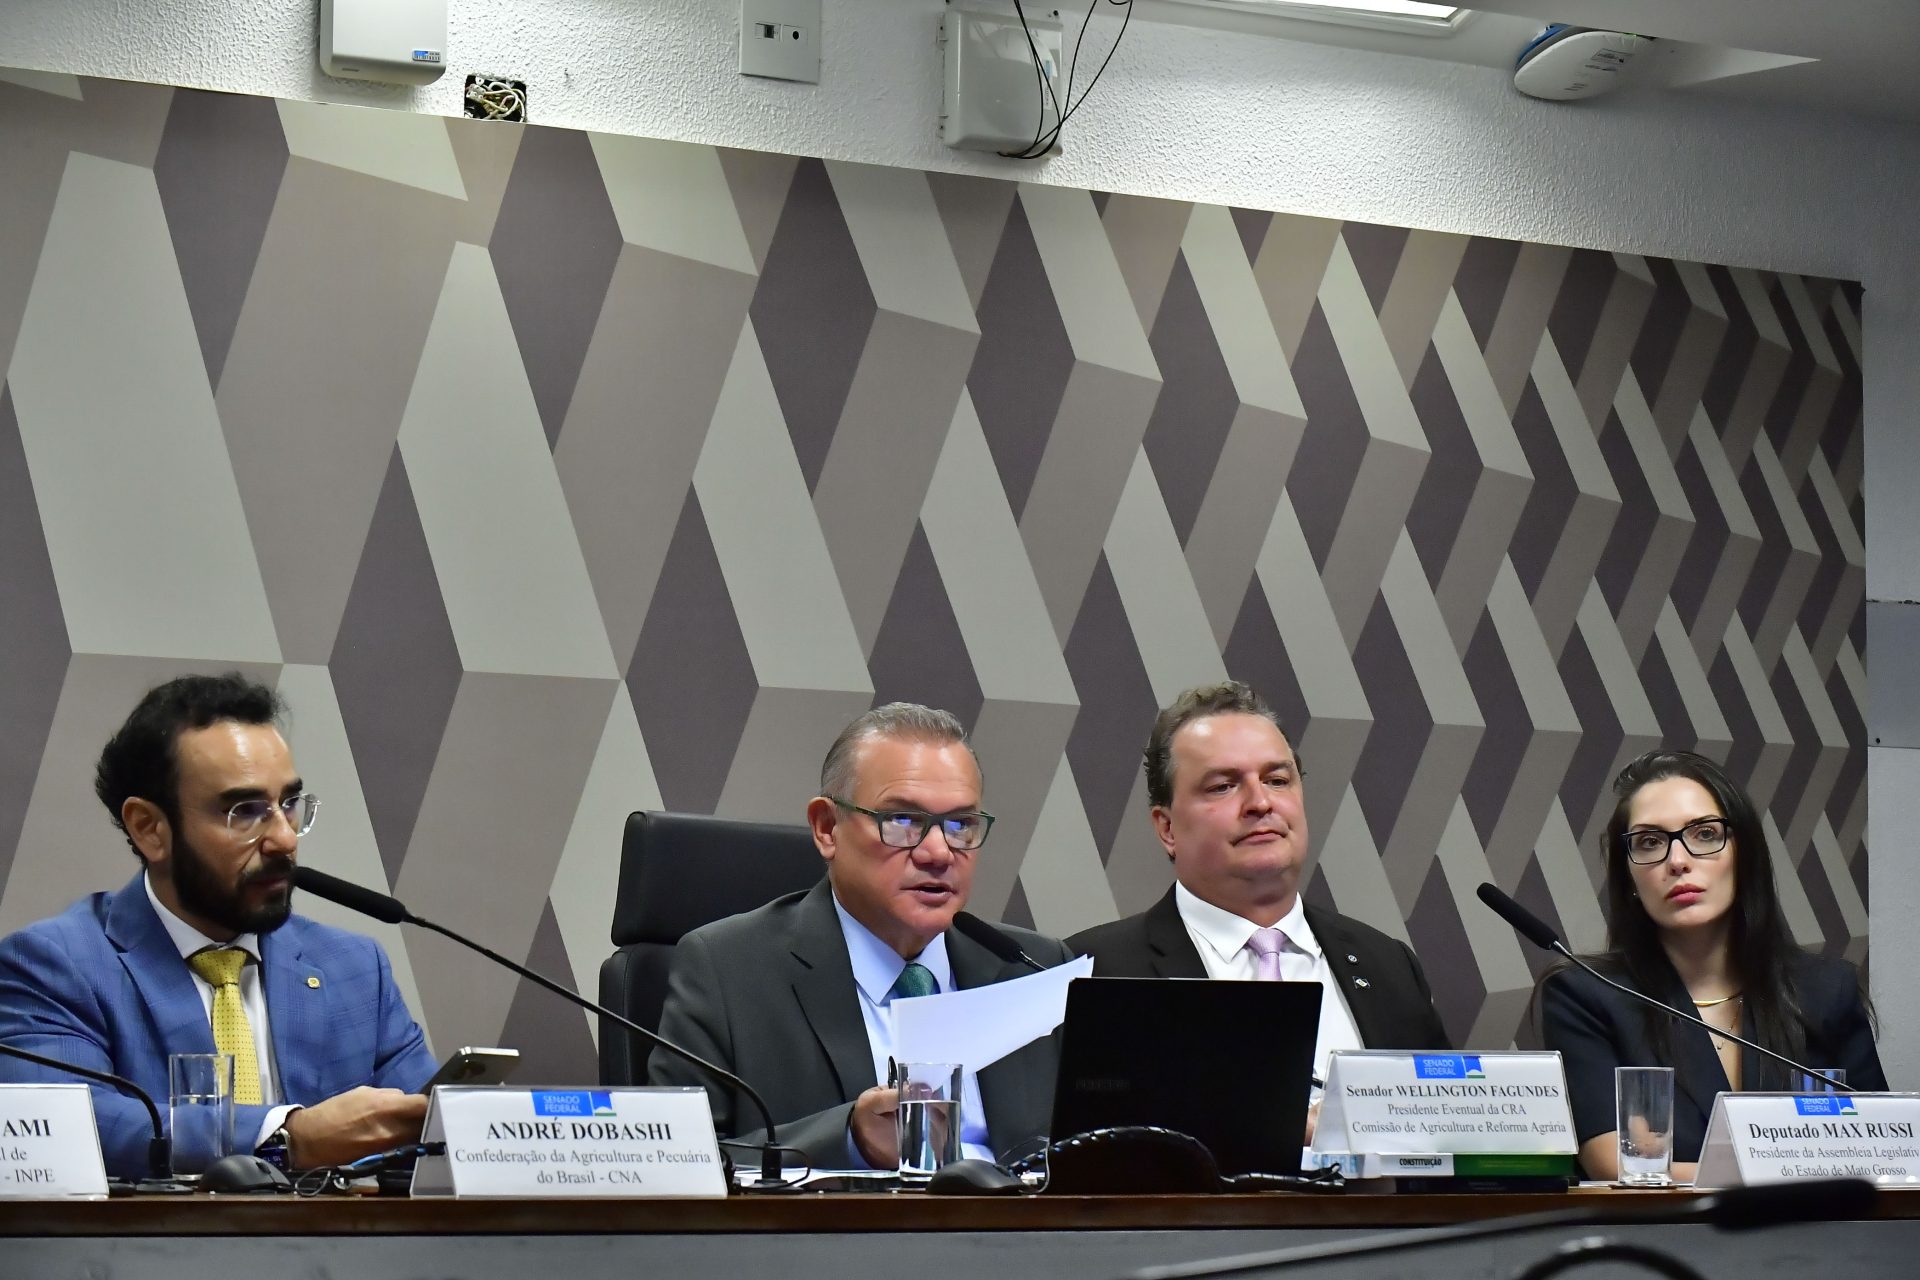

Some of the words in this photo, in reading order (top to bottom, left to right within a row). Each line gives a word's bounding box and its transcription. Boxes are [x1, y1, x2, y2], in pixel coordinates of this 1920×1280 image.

[1423, 1059, 1454, 1068] SENADO
[1424, 1067, 1457, 1076] FEDERAL
[1347, 1085, 1393, 1096] Senador
[1396, 1086, 1486, 1096] WELLINGTON
[1490, 1086, 1558, 1097] FAGUNDES
[543, 1095, 580, 1104] SENADO
[1801, 1097, 1829, 1105] SENADO
[544, 1104, 582, 1113] FEDERAL
[1388, 1104, 1439, 1115] Presidente
[1442, 1104, 1485, 1114] Eventual
[1488, 1104, 1499, 1114] da
[1502, 1104, 1526, 1115] CRA
[1803, 1105, 1832, 1113] FEDERAL
[488, 1117, 565, 1139] ANDRÉ
[571, 1123, 671, 1140] DOBASHI
[1353, 1121, 1401, 1132] Comissão
[1404, 1121, 1415, 1132] de
[1420, 1121, 1475, 1135] Agricultura
[1486, 1121, 1528, 1132] Reforma
[1531, 1121, 1566, 1135] Agrária
[1749, 1123, 1819, 1142] Deputado
[1823, 1123, 1863, 1138] MAX
[1866, 1123, 1913, 1138] RUSSI
[11, 1147, 26, 1160] de
[455, 1148, 547, 1166] Confederação
[550, 1149, 566, 1162] da
[571, 1150, 643, 1166] Agricultura
[646, 1154, 653, 1163] e
[657, 1150, 711, 1163] Pecuária
[1749, 1147, 1799, 1158] Presidente
[1803, 1147, 1815, 1158] da
[1818, 1146, 1872, 1158] Assembleia
[1399, 1155, 1442, 1167] CONSTITUIÇÃO
[15, 1169, 55, 1182] INPE
[1781, 1164, 1793, 1176] do
[1796, 1164, 1829, 1176] Estado
[1831, 1164, 1842, 1176] de
[1844, 1164, 1870, 1175] Mato
[1873, 1164, 1906, 1175] Grosso
[537, 1170, 553, 1184] do
[557, 1171, 595, 1184] Brasil
[608, 1171, 642, 1184] CNA
